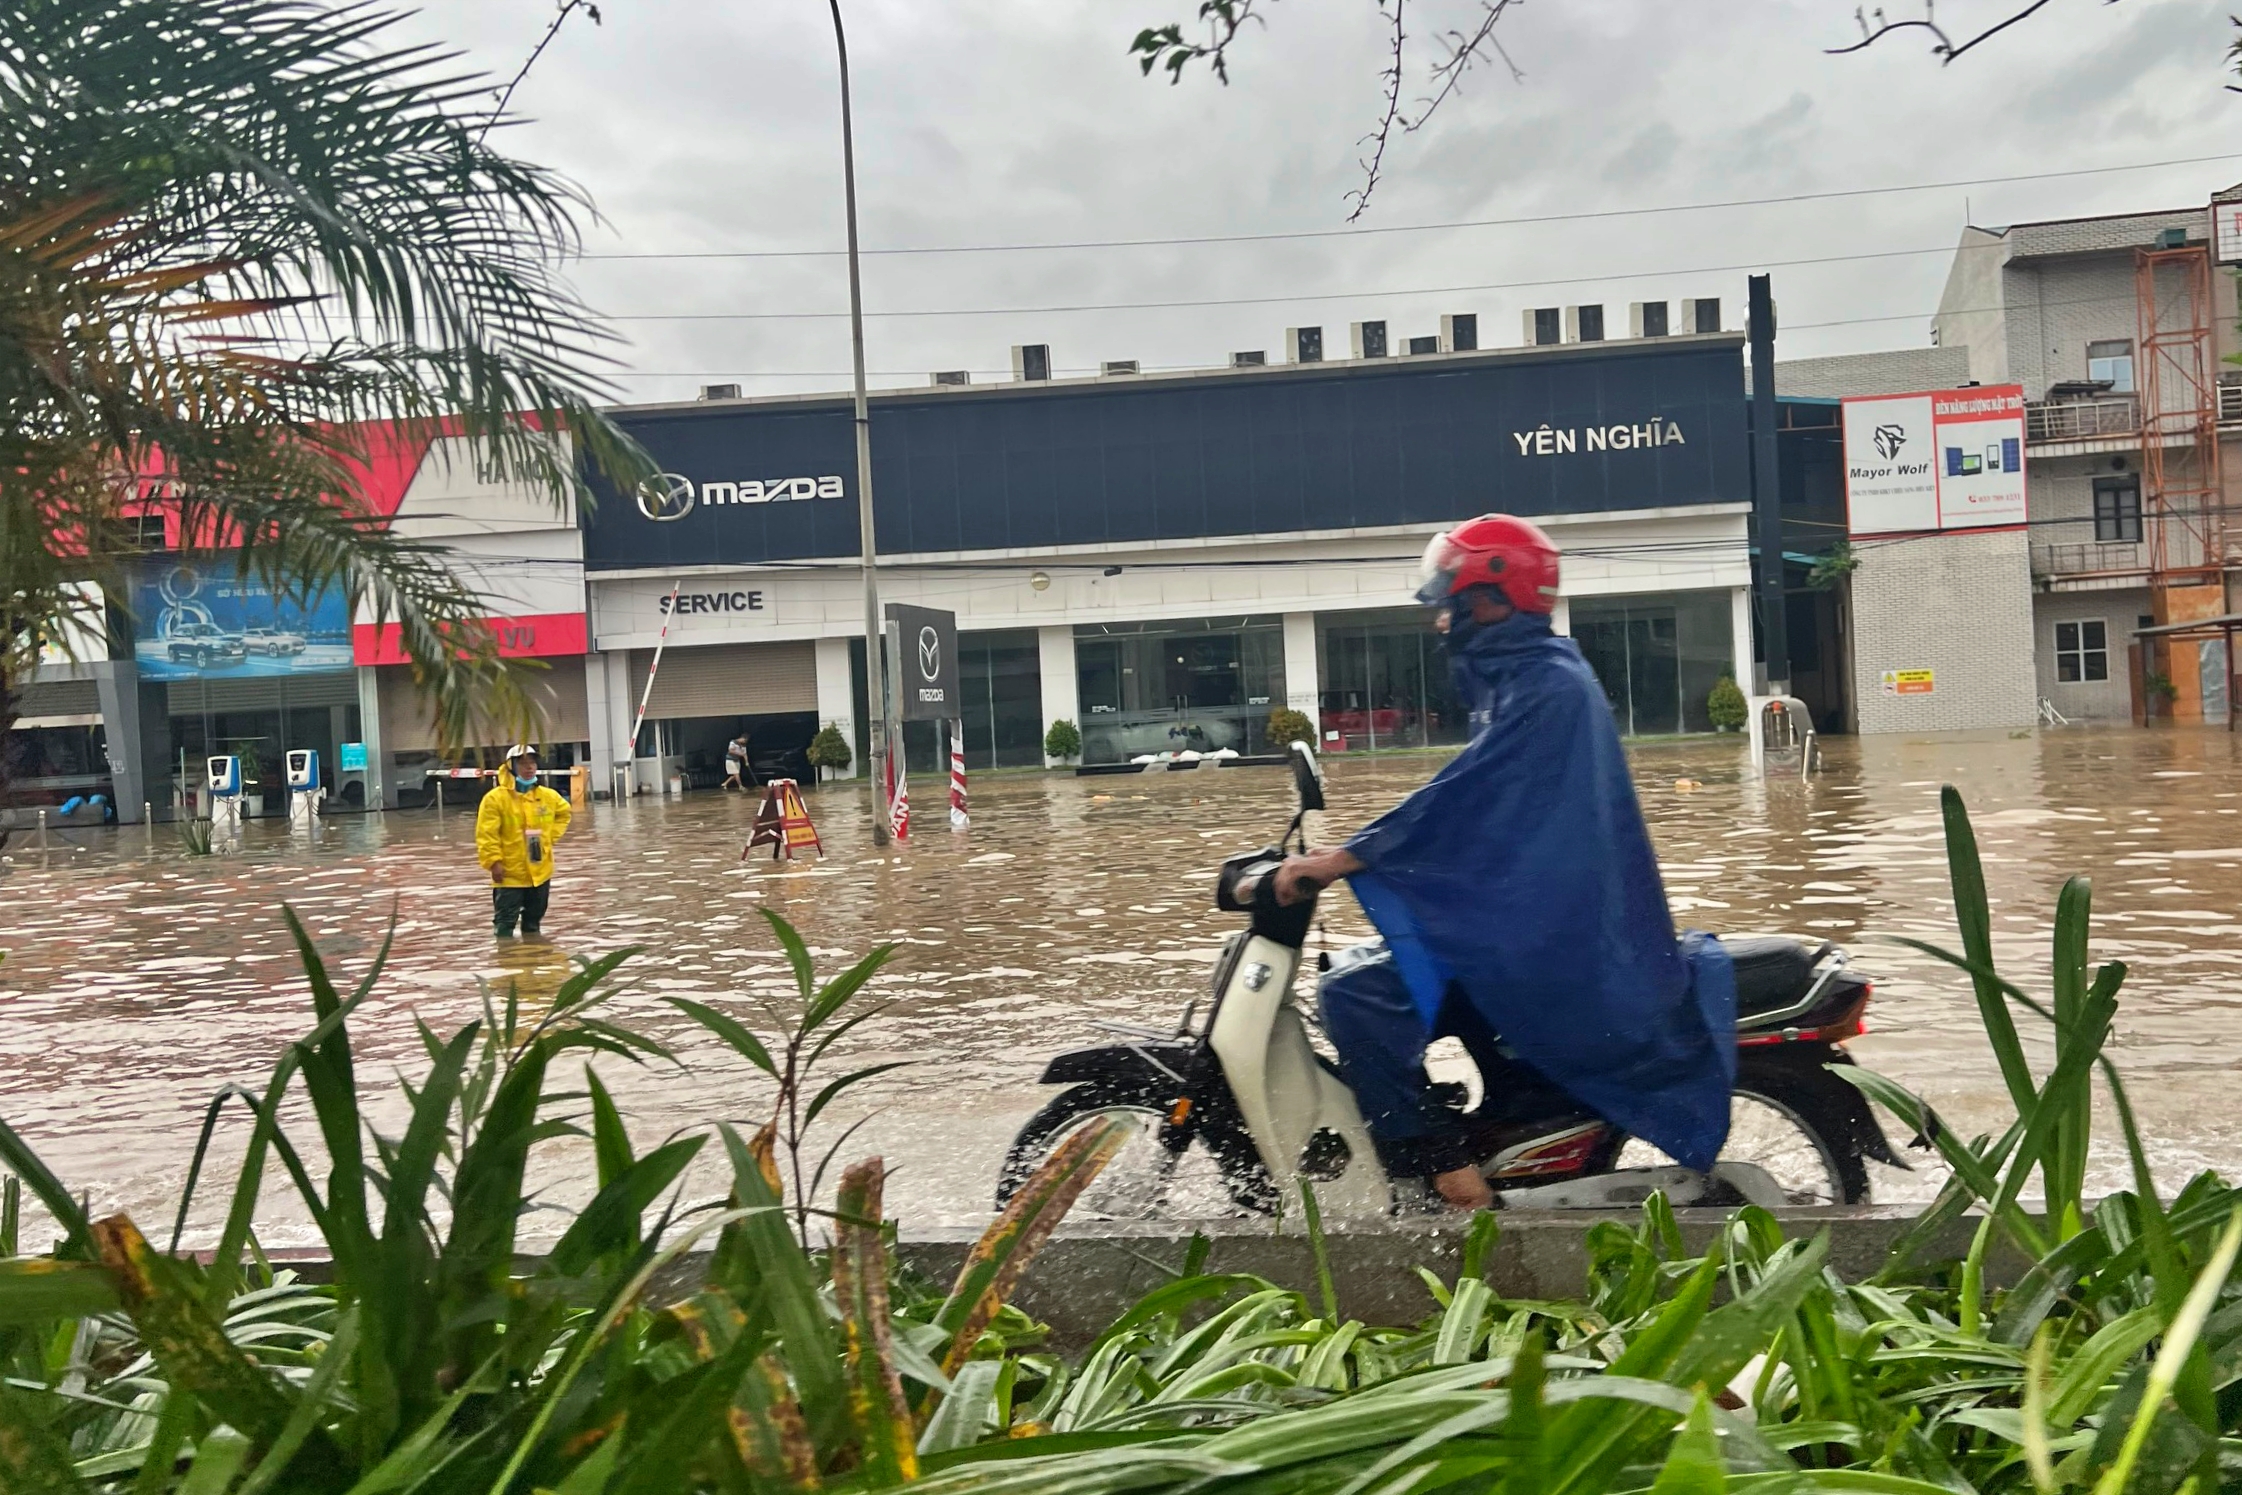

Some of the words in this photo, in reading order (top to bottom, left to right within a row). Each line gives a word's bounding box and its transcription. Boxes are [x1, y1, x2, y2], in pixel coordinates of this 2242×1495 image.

[1513, 424, 1576, 456] YÊN
[1586, 416, 1686, 452] NGHĨA
[1850, 468, 1892, 480] Mayor
[1897, 463, 1929, 475] Wolf
[660, 591, 763, 615] SERVICE
